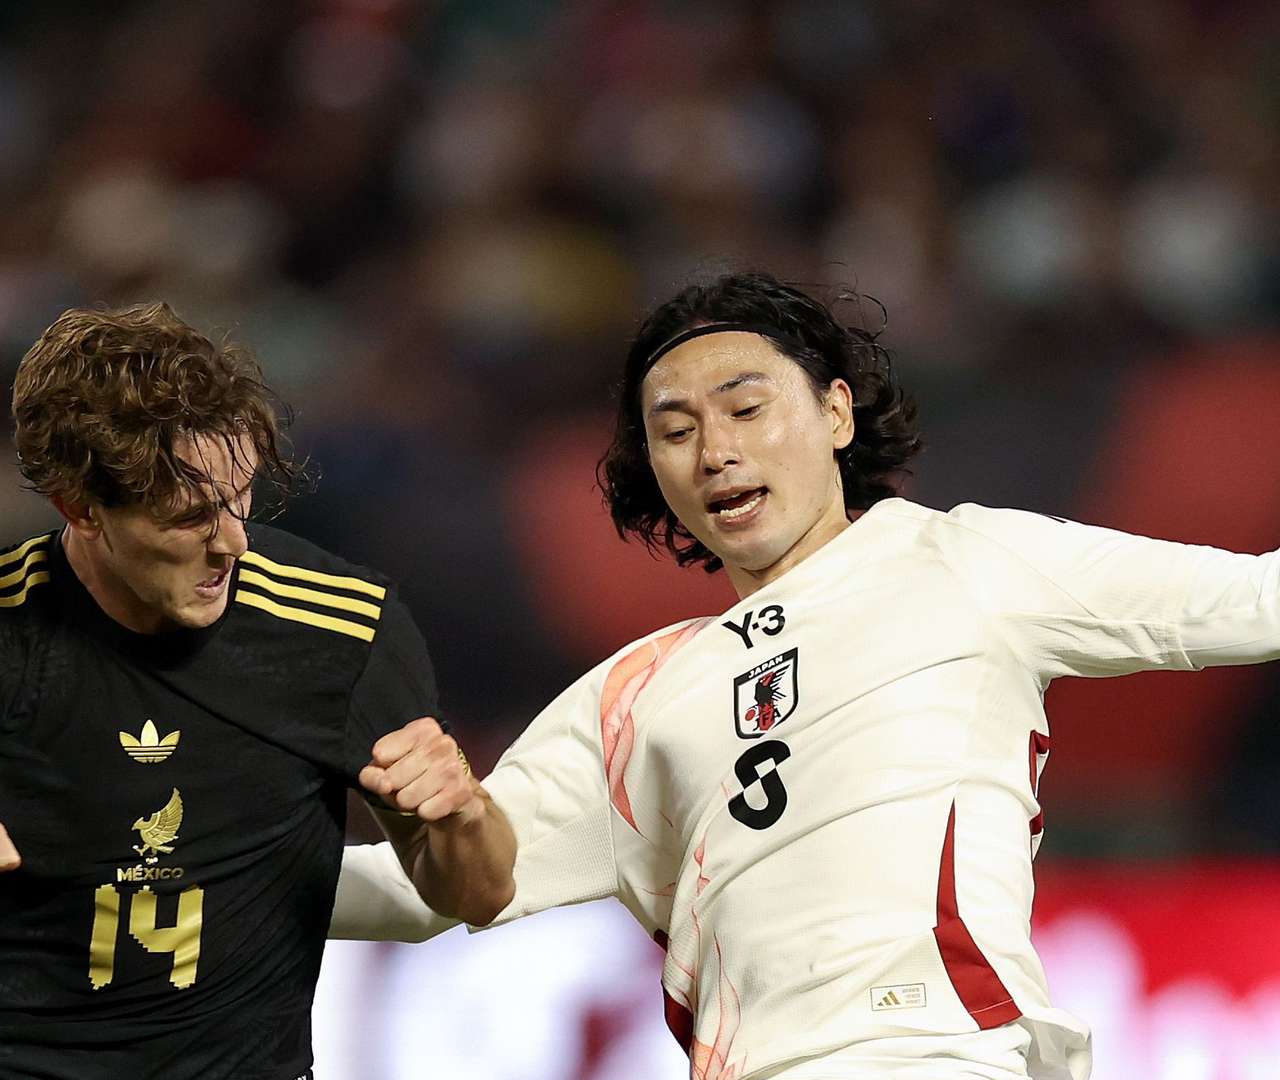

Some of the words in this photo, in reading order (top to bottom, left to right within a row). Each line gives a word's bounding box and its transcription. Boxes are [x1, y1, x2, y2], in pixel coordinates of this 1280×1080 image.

[721, 604, 786, 649] Y-3
[748, 655, 783, 679] JAPAN
[116, 864, 184, 882] MÉXICO
[88, 883, 204, 990] 14
